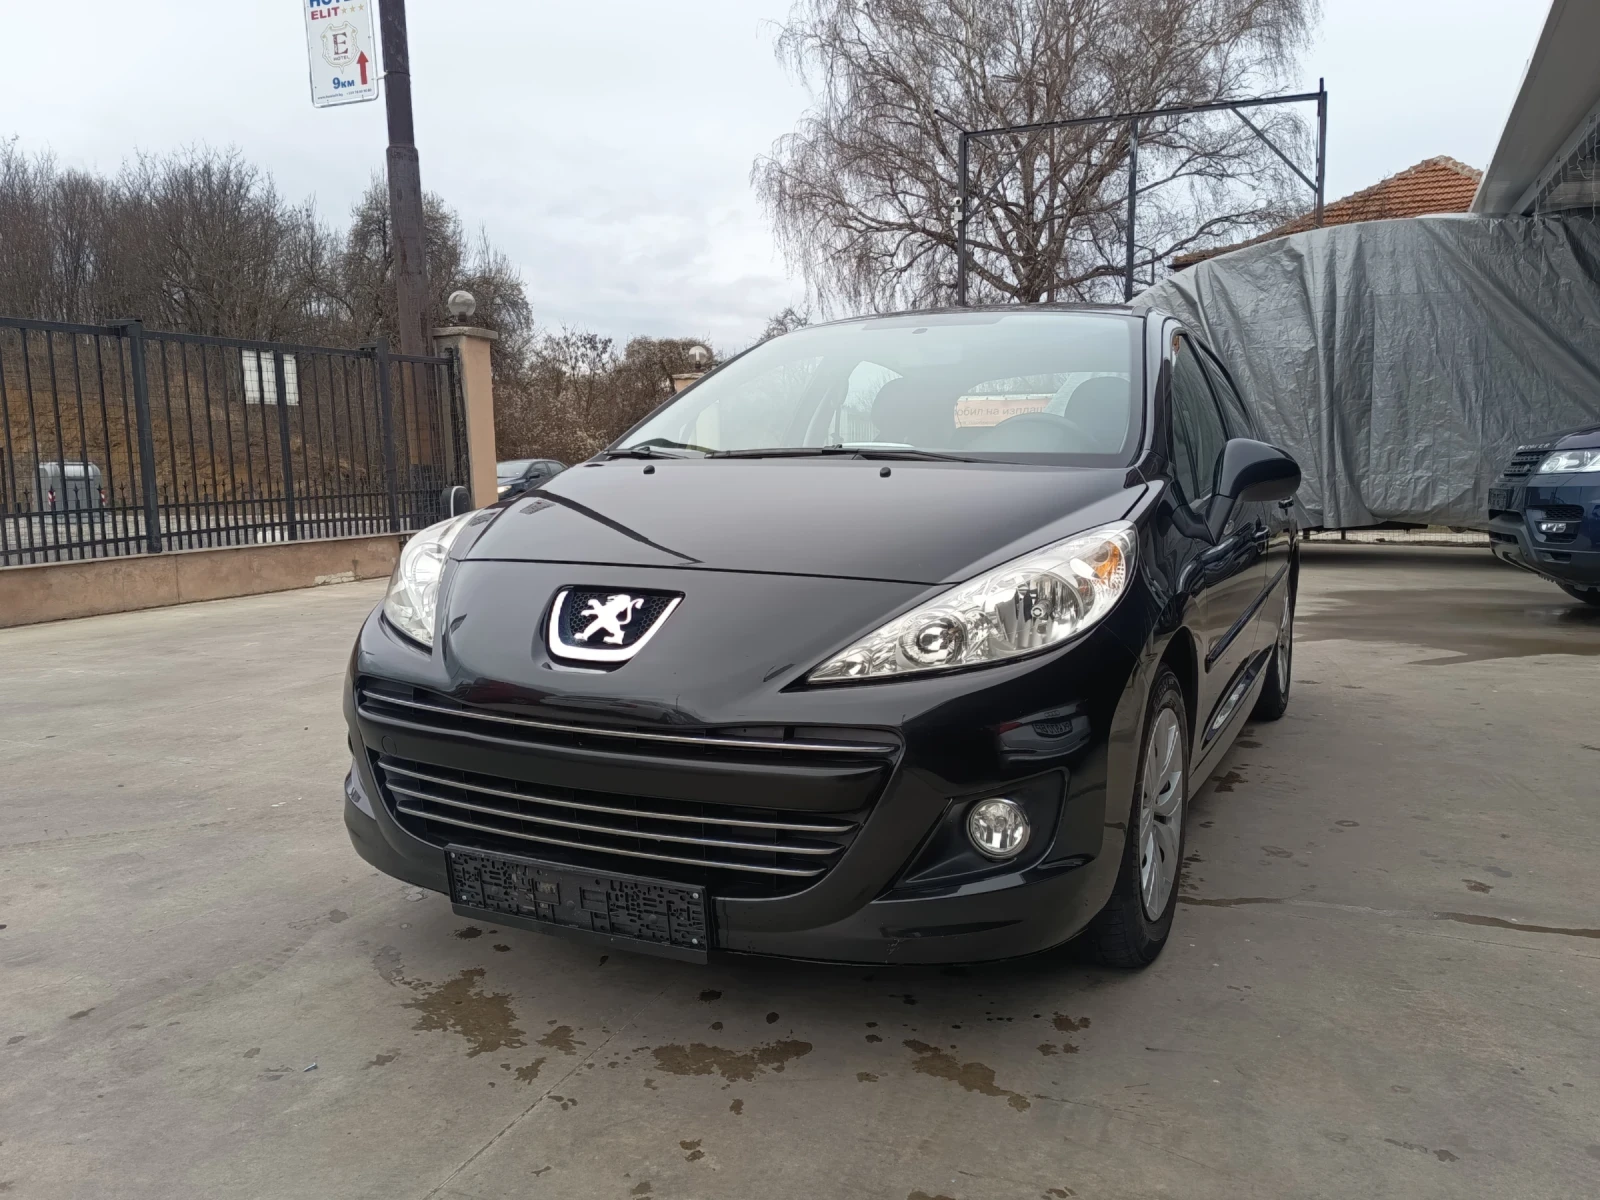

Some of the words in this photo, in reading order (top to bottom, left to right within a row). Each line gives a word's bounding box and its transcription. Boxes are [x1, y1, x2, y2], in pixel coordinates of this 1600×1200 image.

[311, 6, 340, 20] ELIT
[332, 32, 348, 55] E
[986, 408, 999, 416] на
